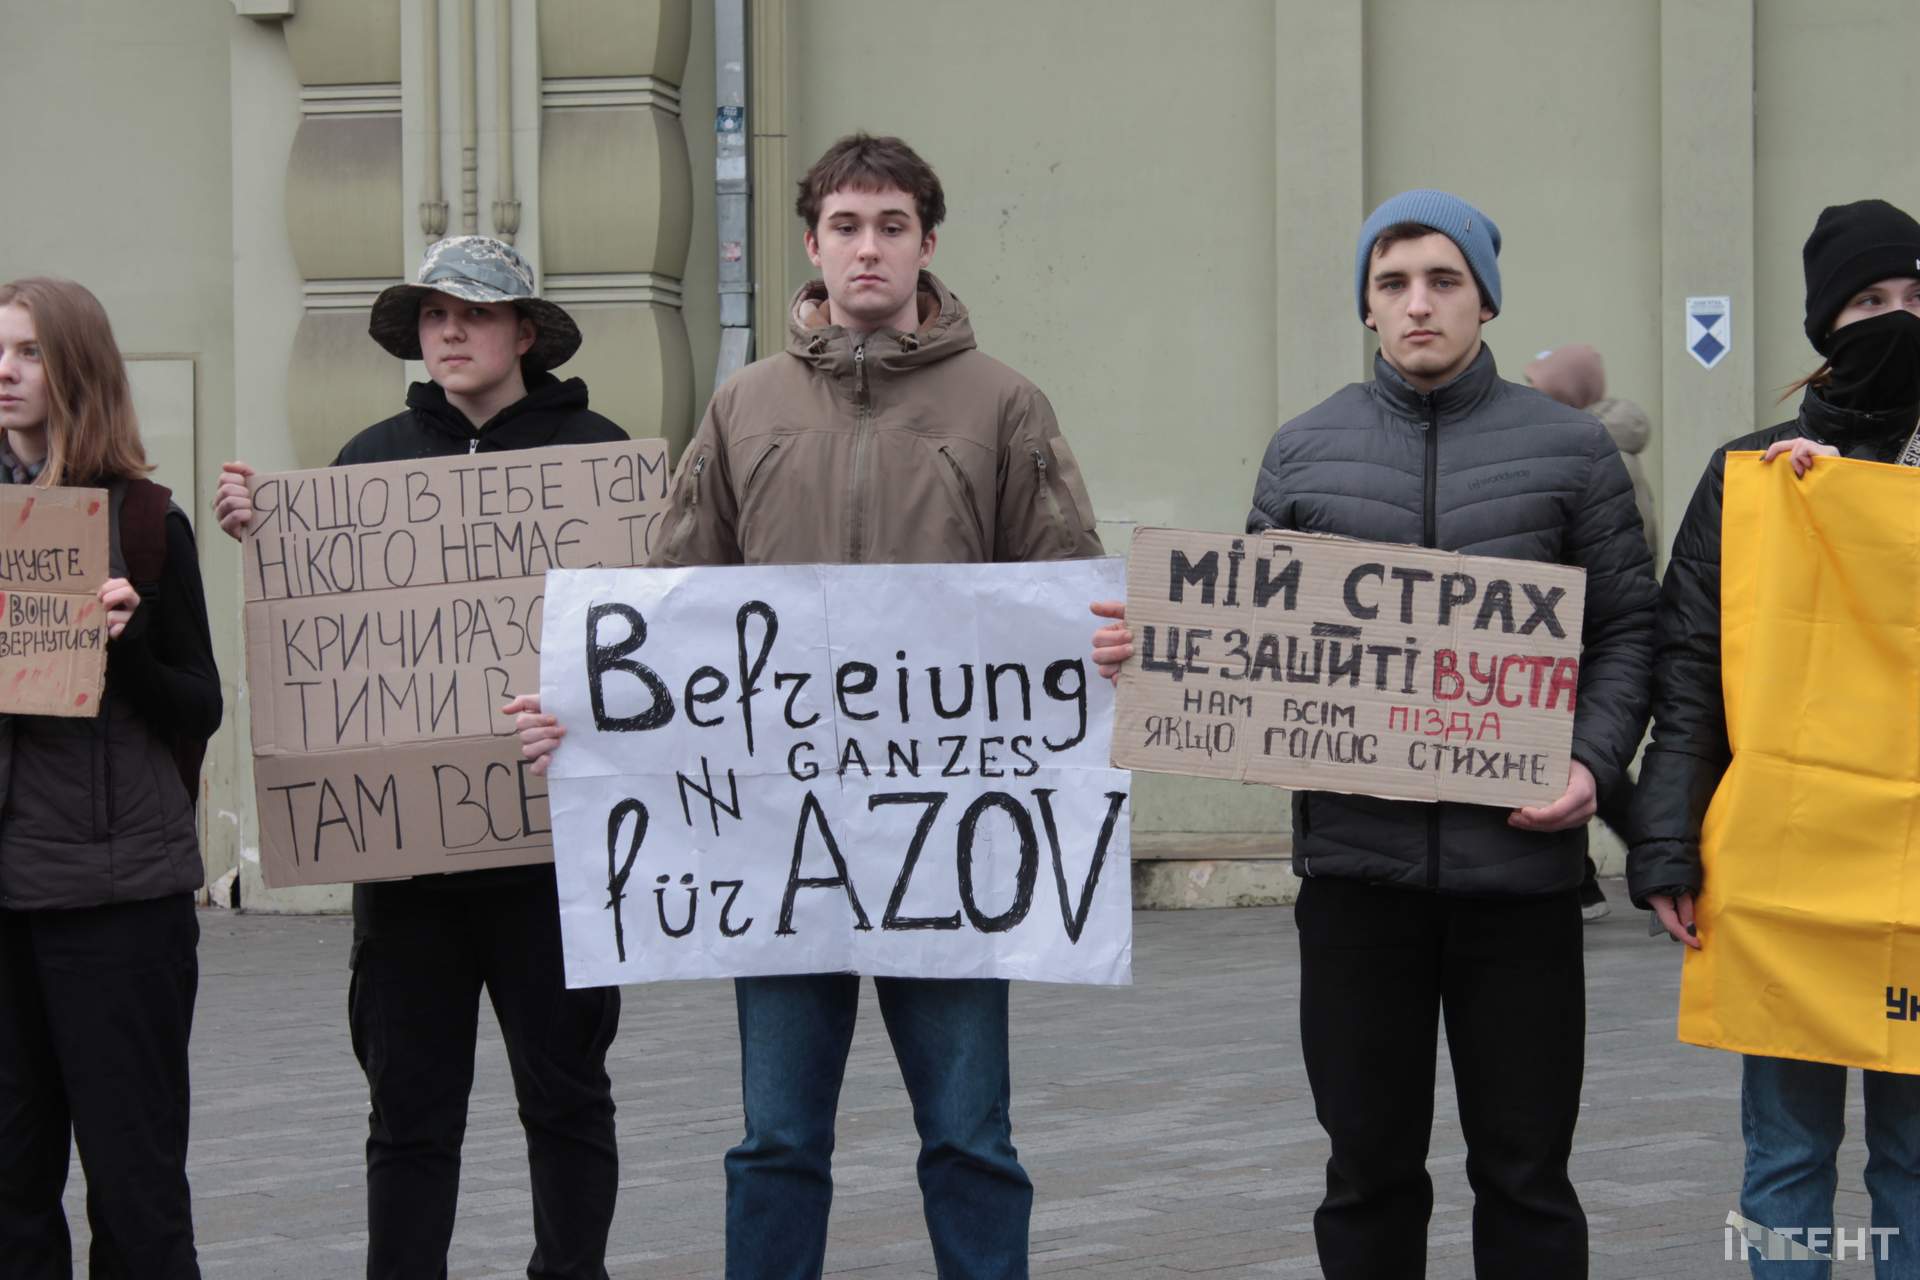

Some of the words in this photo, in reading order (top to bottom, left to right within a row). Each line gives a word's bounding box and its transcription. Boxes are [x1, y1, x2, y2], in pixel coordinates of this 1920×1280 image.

[250, 475, 389, 536] ЯКЩО
[406, 472, 441, 523] В
[449, 462, 564, 517] ТЕБЕ
[10, 594, 69, 628] ВОНИ
[1169, 538, 1303, 611] МІЙ
[1343, 563, 1567, 639] СТРАХ
[284, 669, 459, 752] ТИМИ
[585, 600, 1088, 757] Befreiung
[1141, 625, 1212, 682] ЦЕ
[1432, 648, 1579, 713] ВУСТА
[1144, 715, 1236, 760] ЯКЩО
[1263, 727, 1378, 765] ГОЛОС
[1408, 740, 1550, 787] СТИХНЕ
[1184, 688, 1252, 717] НАМ
[1283, 698, 1356, 729] ВСІМ
[1388, 705, 1502, 743] ПІЗДА
[787, 735, 1040, 781] GANZES
[267, 773, 402, 866] ТАМ
[433, 759, 553, 848] ВСЕ
[604, 797, 753, 963] für
[775, 789, 1128, 945] AZOV
